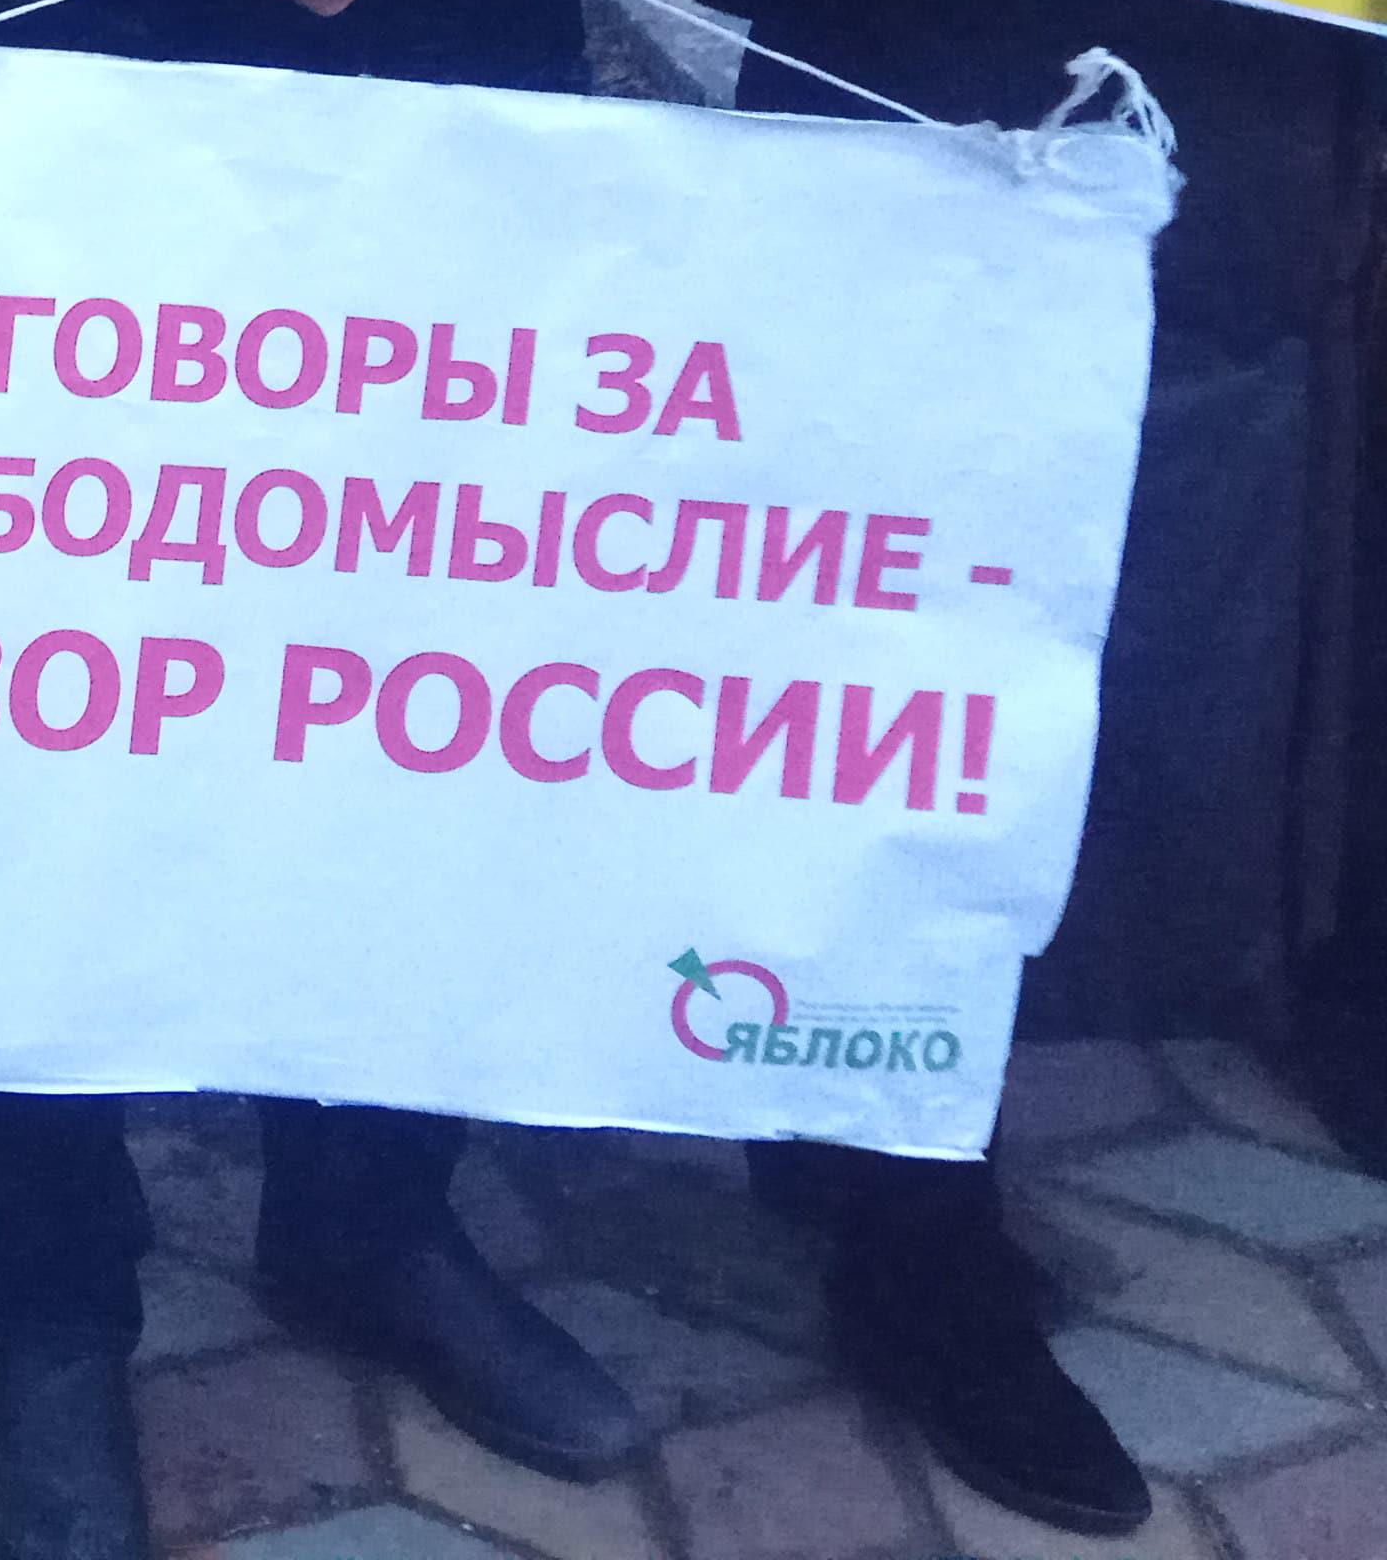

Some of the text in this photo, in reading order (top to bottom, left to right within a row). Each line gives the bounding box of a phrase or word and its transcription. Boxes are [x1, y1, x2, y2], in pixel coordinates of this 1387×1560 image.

[574, 332, 744, 442] ЗА
[272, 643, 996, 816] РОССИИ!
[725, 1021, 964, 1073] ЯБЛОКО
